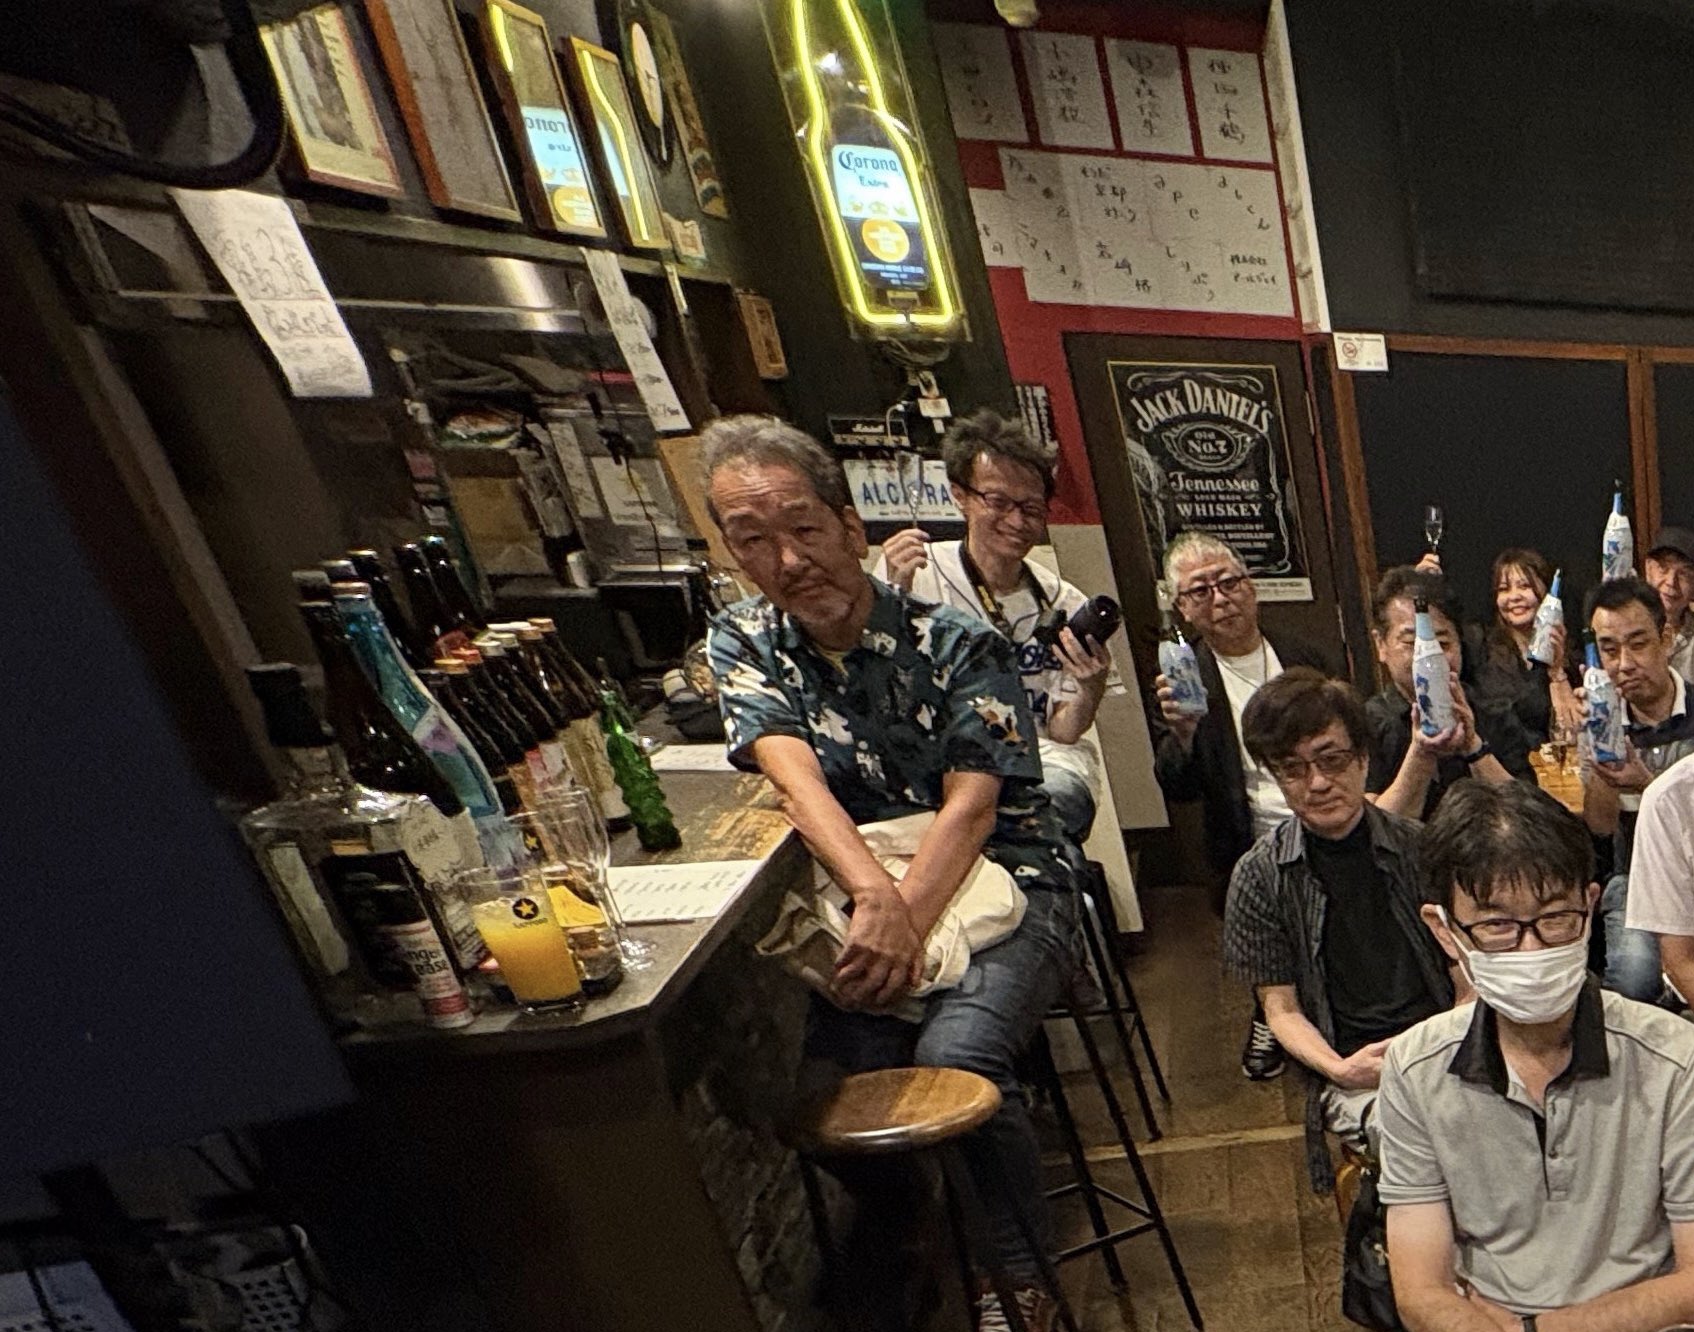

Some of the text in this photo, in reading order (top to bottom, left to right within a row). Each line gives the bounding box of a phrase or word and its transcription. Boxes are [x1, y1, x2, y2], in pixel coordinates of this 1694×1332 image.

[838, 151, 899, 172] Corona
[858, 175, 889, 188] Extra
[1130, 387, 1185, 433] JACK
[1169, 471, 1259, 492] Tennessee
[1176, 503, 1263, 517] WHISKEY
